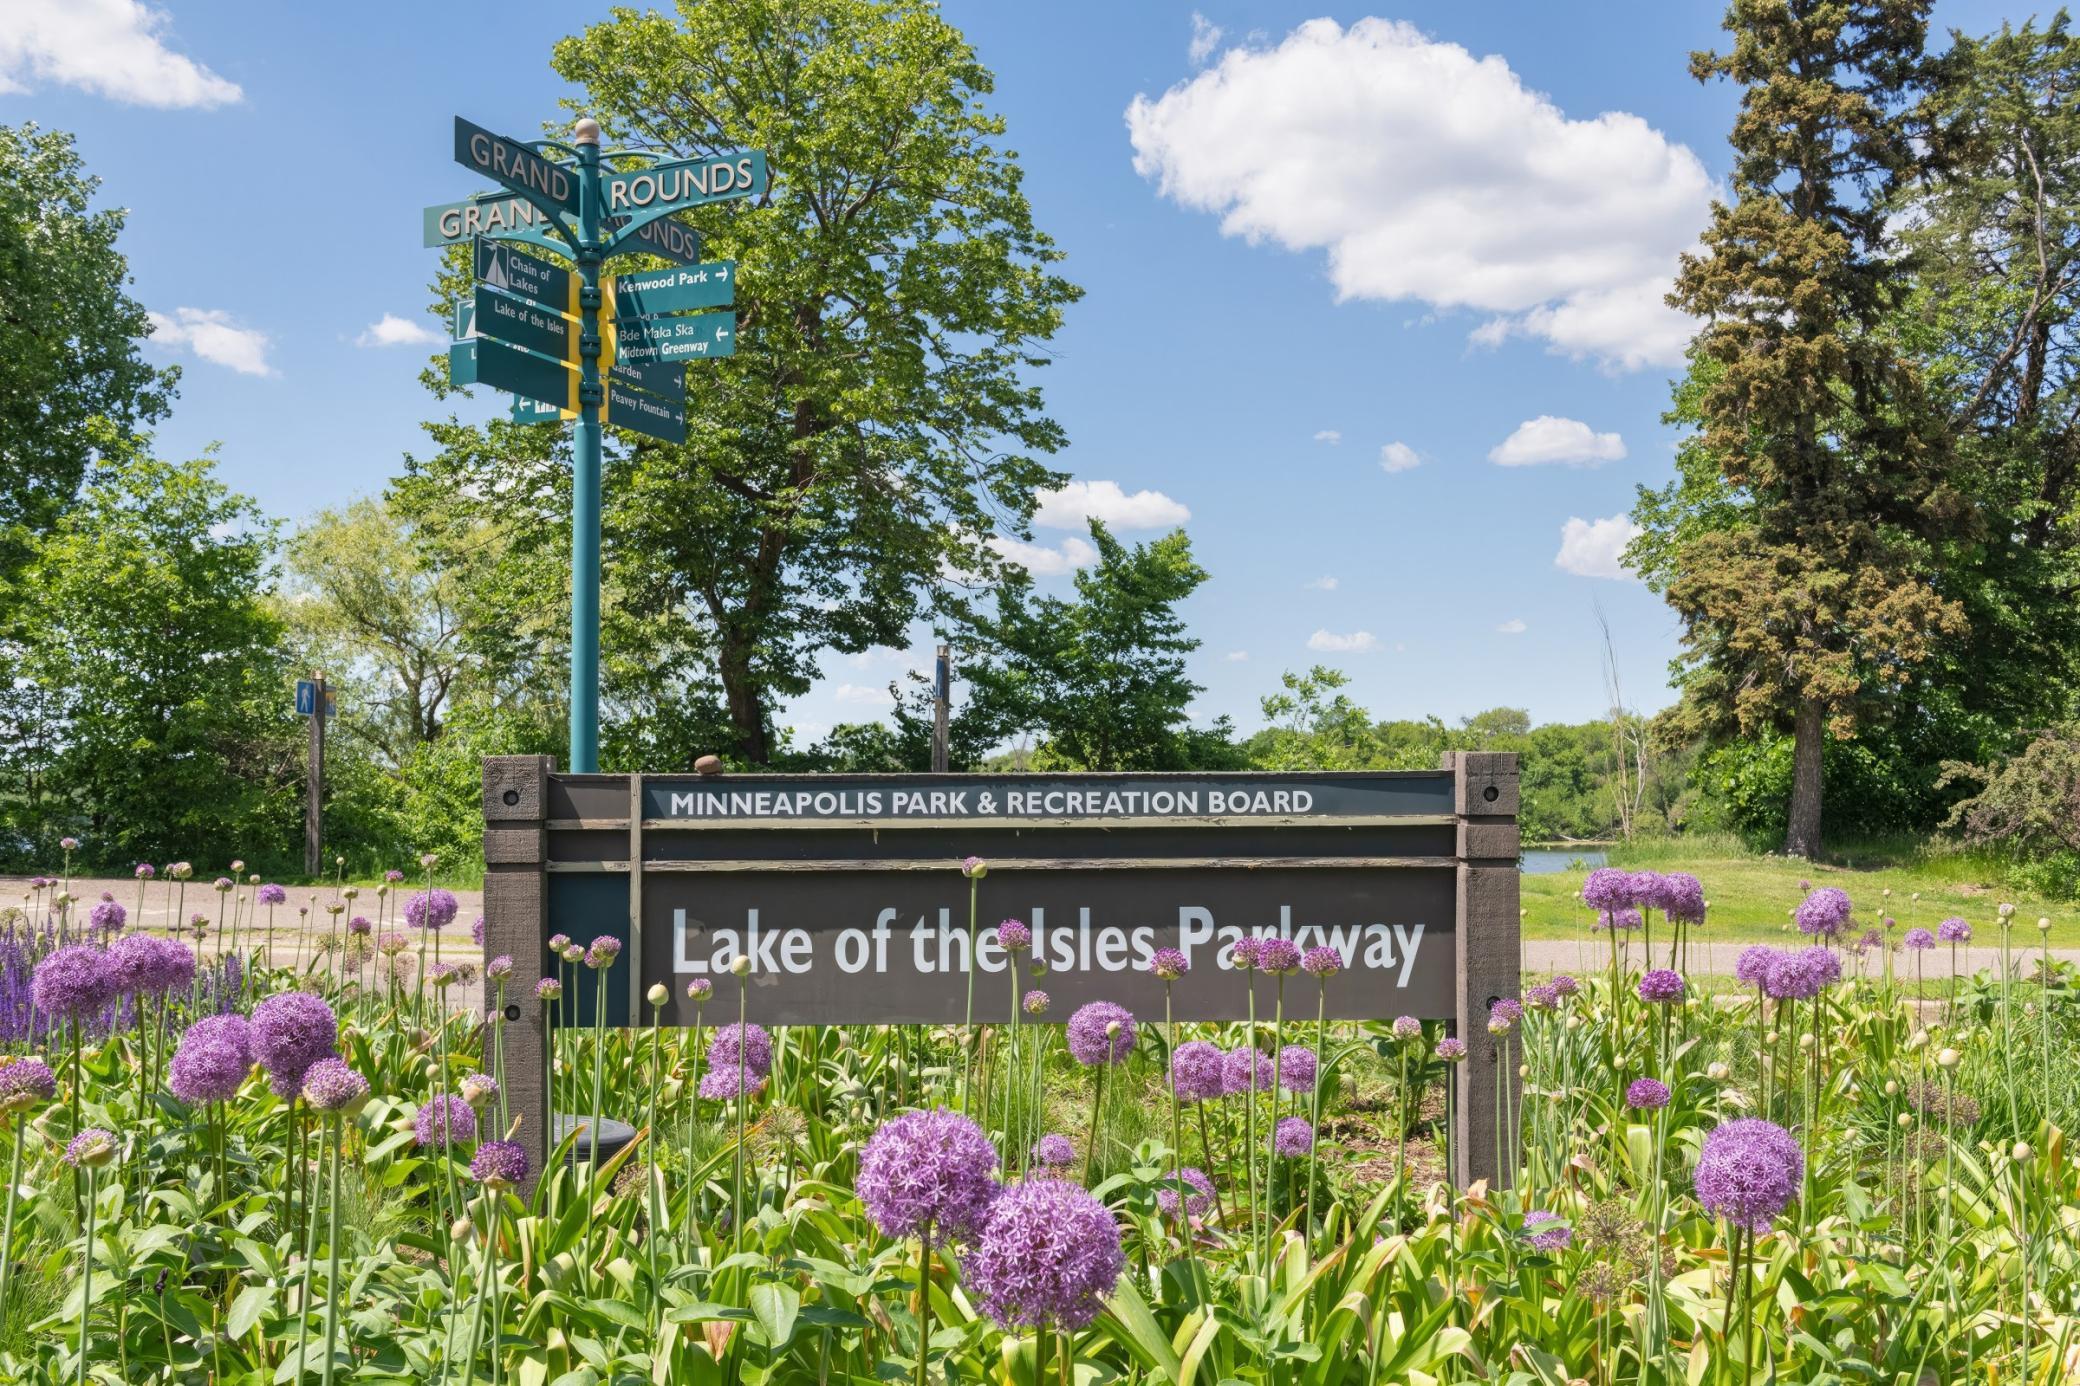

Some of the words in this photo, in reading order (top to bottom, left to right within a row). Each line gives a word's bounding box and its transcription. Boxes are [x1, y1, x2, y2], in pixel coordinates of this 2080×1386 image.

[471, 133, 569, 201] GRAND
[611, 158, 753, 209] ROUNDS
[510, 256, 538, 277] Chain
[540, 269, 551, 282] of
[618, 275, 675, 294] Kenwood
[679, 270, 708, 285] Park
[510, 273, 539, 295] Lakes
[494, 299, 516, 318] Lake
[518, 311, 528, 323] of
[530, 313, 545, 329] the
[547, 317, 565, 336] Isles
[619, 329, 640, 342] Bde
[643, 325, 672, 340] Maka
[675, 323, 694, 336] Ska
[619, 344, 658, 359] Midtown
[661, 340, 709, 355] Greenway
[611, 389, 638, 409] Peavey
[639, 398, 670, 419] Fountain
[670, 791, 883, 816] MINNEAPOLIS
[892, 791, 968, 815] PARK
[976, 791, 997, 815] &
[1007, 790, 1199, 815] RECREATION
[1208, 790, 1314, 814] BOARD
[672, 908, 814, 975] Lake
[834, 907, 897, 974] of
[910, 907, 1007, 974] the
[1031, 906, 1155, 973] Isles
[1178, 905, 1426, 988] Parkway
